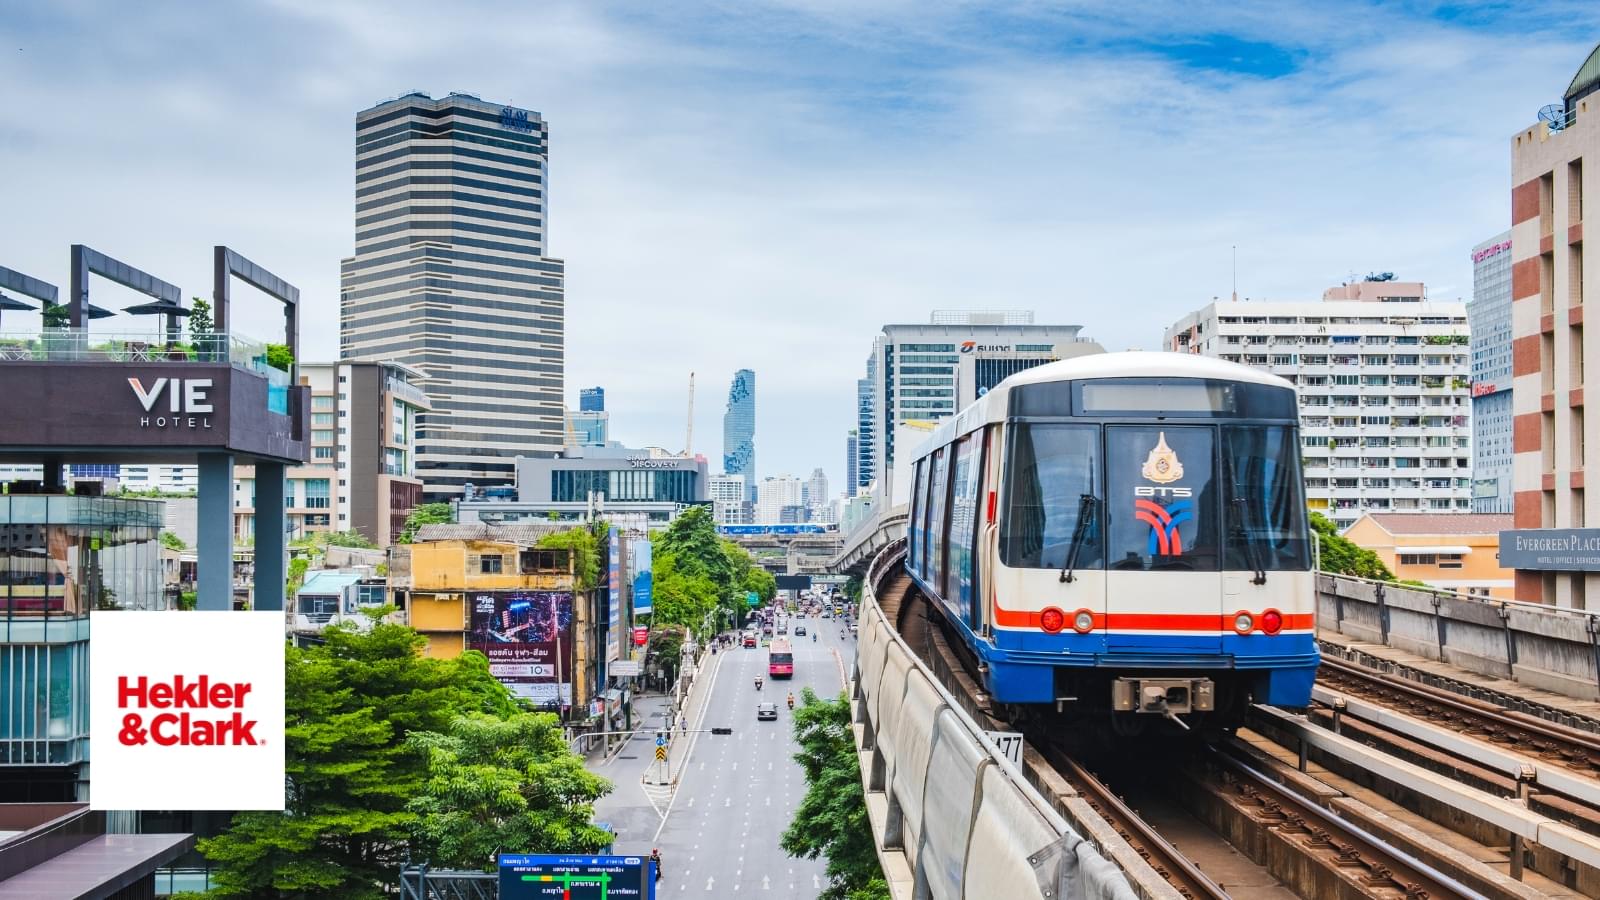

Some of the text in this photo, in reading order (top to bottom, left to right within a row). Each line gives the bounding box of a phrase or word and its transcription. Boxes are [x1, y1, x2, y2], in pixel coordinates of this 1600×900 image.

[128, 378, 213, 413] VIE
[141, 417, 211, 428] HOTEL
[1134, 486, 1193, 497] BTS
[530, 666, 543, 675] 10
